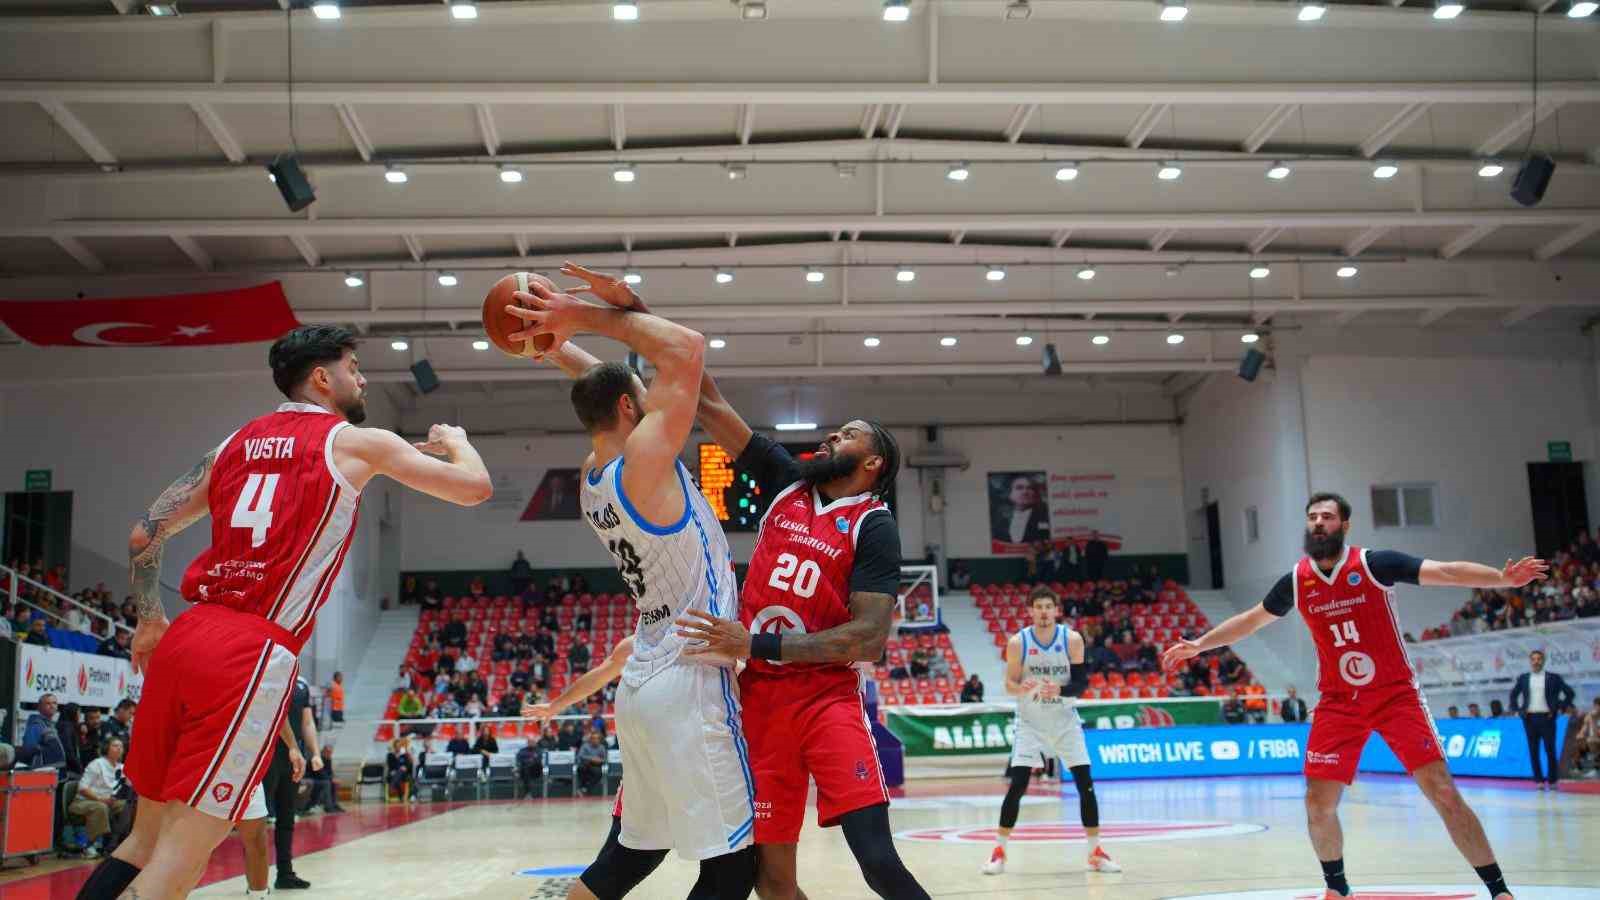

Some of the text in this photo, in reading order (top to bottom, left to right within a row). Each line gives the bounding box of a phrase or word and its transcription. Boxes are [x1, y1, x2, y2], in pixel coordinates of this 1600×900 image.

[244, 436, 296, 462] YUSTA
[230, 473, 281, 548] 4
[768, 552, 821, 599] 20
[1308, 593, 1367, 614] Casademont
[1329, 619, 1361, 648] 14
[36, 673, 67, 694] SOCAR
[933, 720, 1016, 750] ALİA
[1098, 742, 1161, 765] WATCH
[1164, 741, 1205, 763] LIVE
[1258, 738, 1300, 759] FIBA
